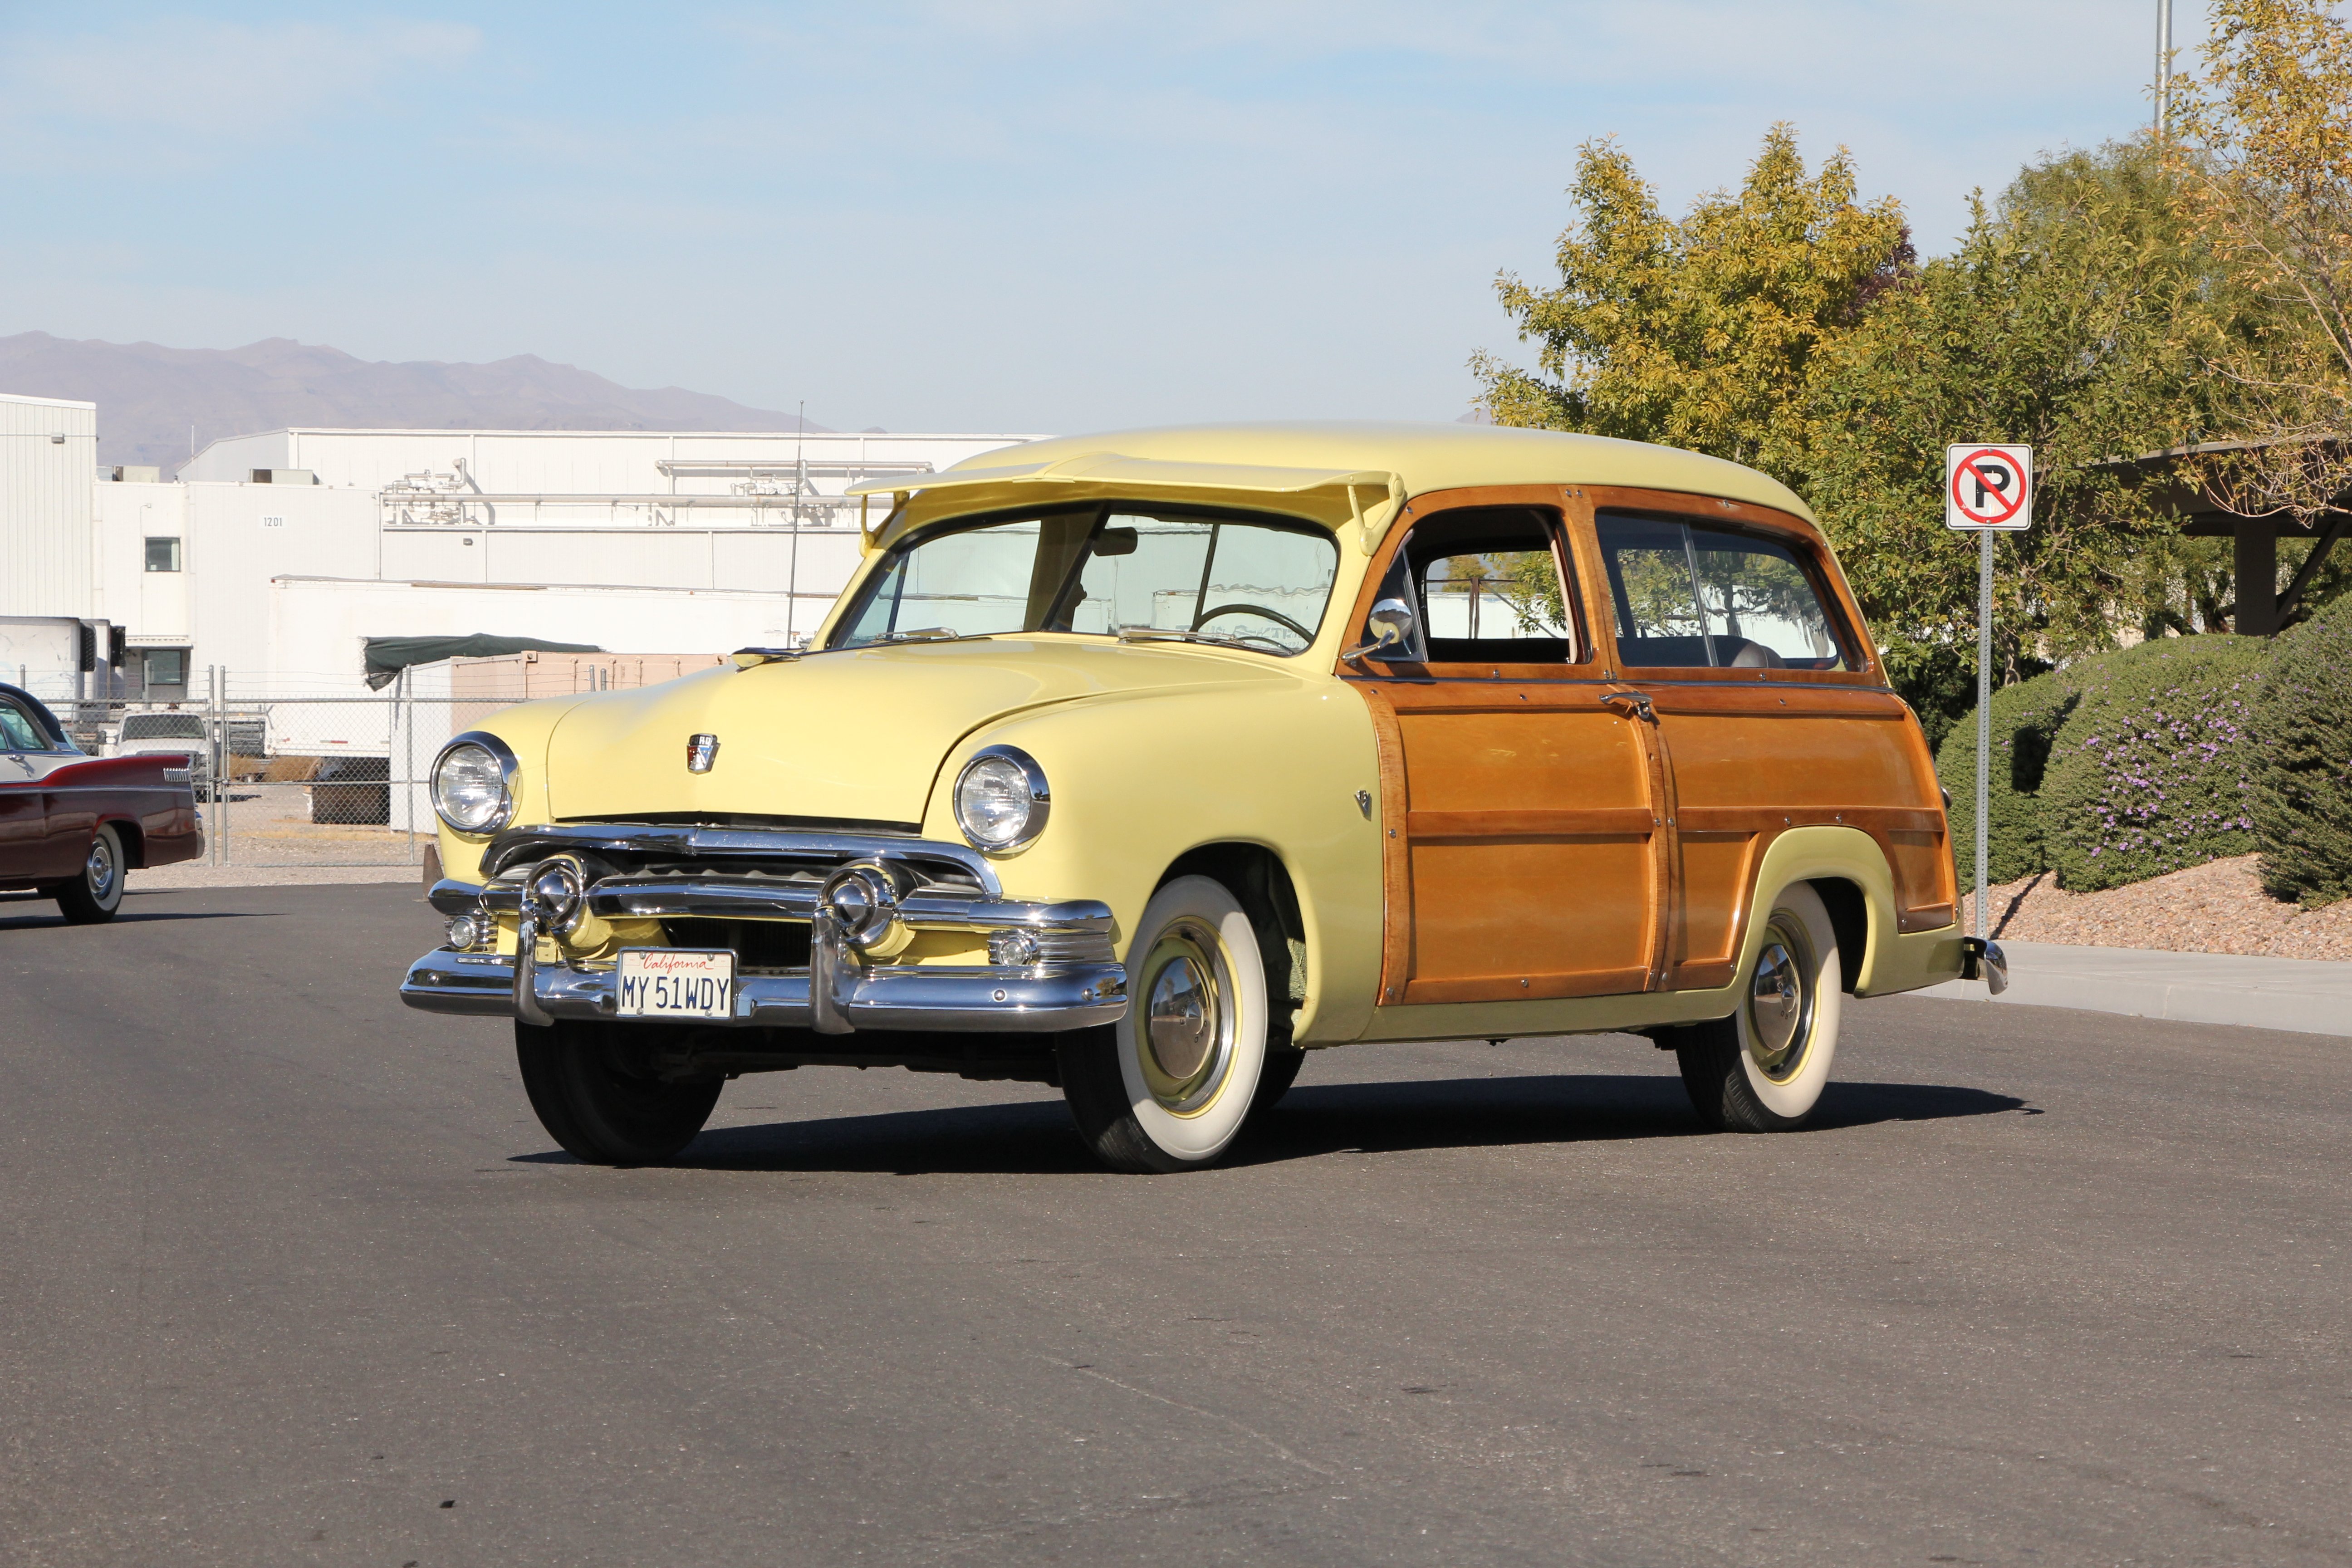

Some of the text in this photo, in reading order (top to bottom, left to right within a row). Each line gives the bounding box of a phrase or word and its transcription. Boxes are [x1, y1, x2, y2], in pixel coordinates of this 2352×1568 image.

[1976, 465, 2011, 508] P
[264, 517, 282, 527] 1201
[690, 735, 711, 745] FORD
[643, 952, 714, 975] California
[622, 975, 729, 1010] MY 51WDY
